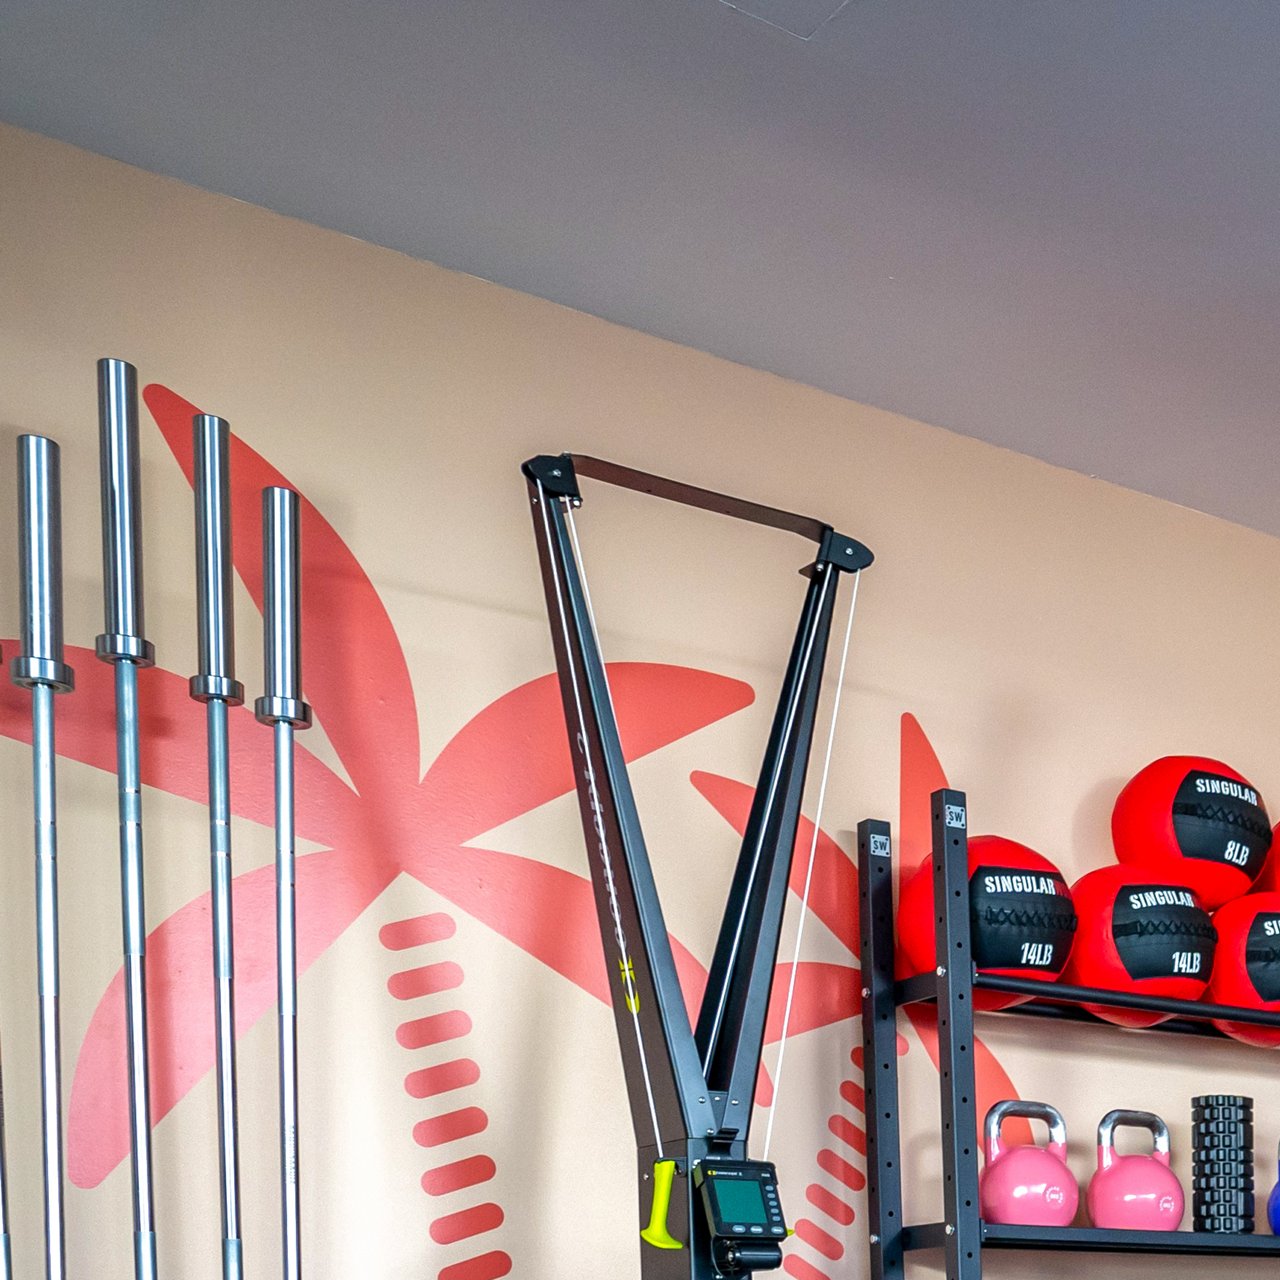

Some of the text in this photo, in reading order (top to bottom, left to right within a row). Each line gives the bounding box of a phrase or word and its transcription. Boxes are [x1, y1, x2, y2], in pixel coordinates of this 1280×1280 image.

[947, 811, 963, 823] SW
[873, 840, 887, 852] SW
[1224, 840, 1250, 866] 8LB
[1021, 943, 1053, 965] 14LB
[1172, 952, 1201, 973] 14LB
